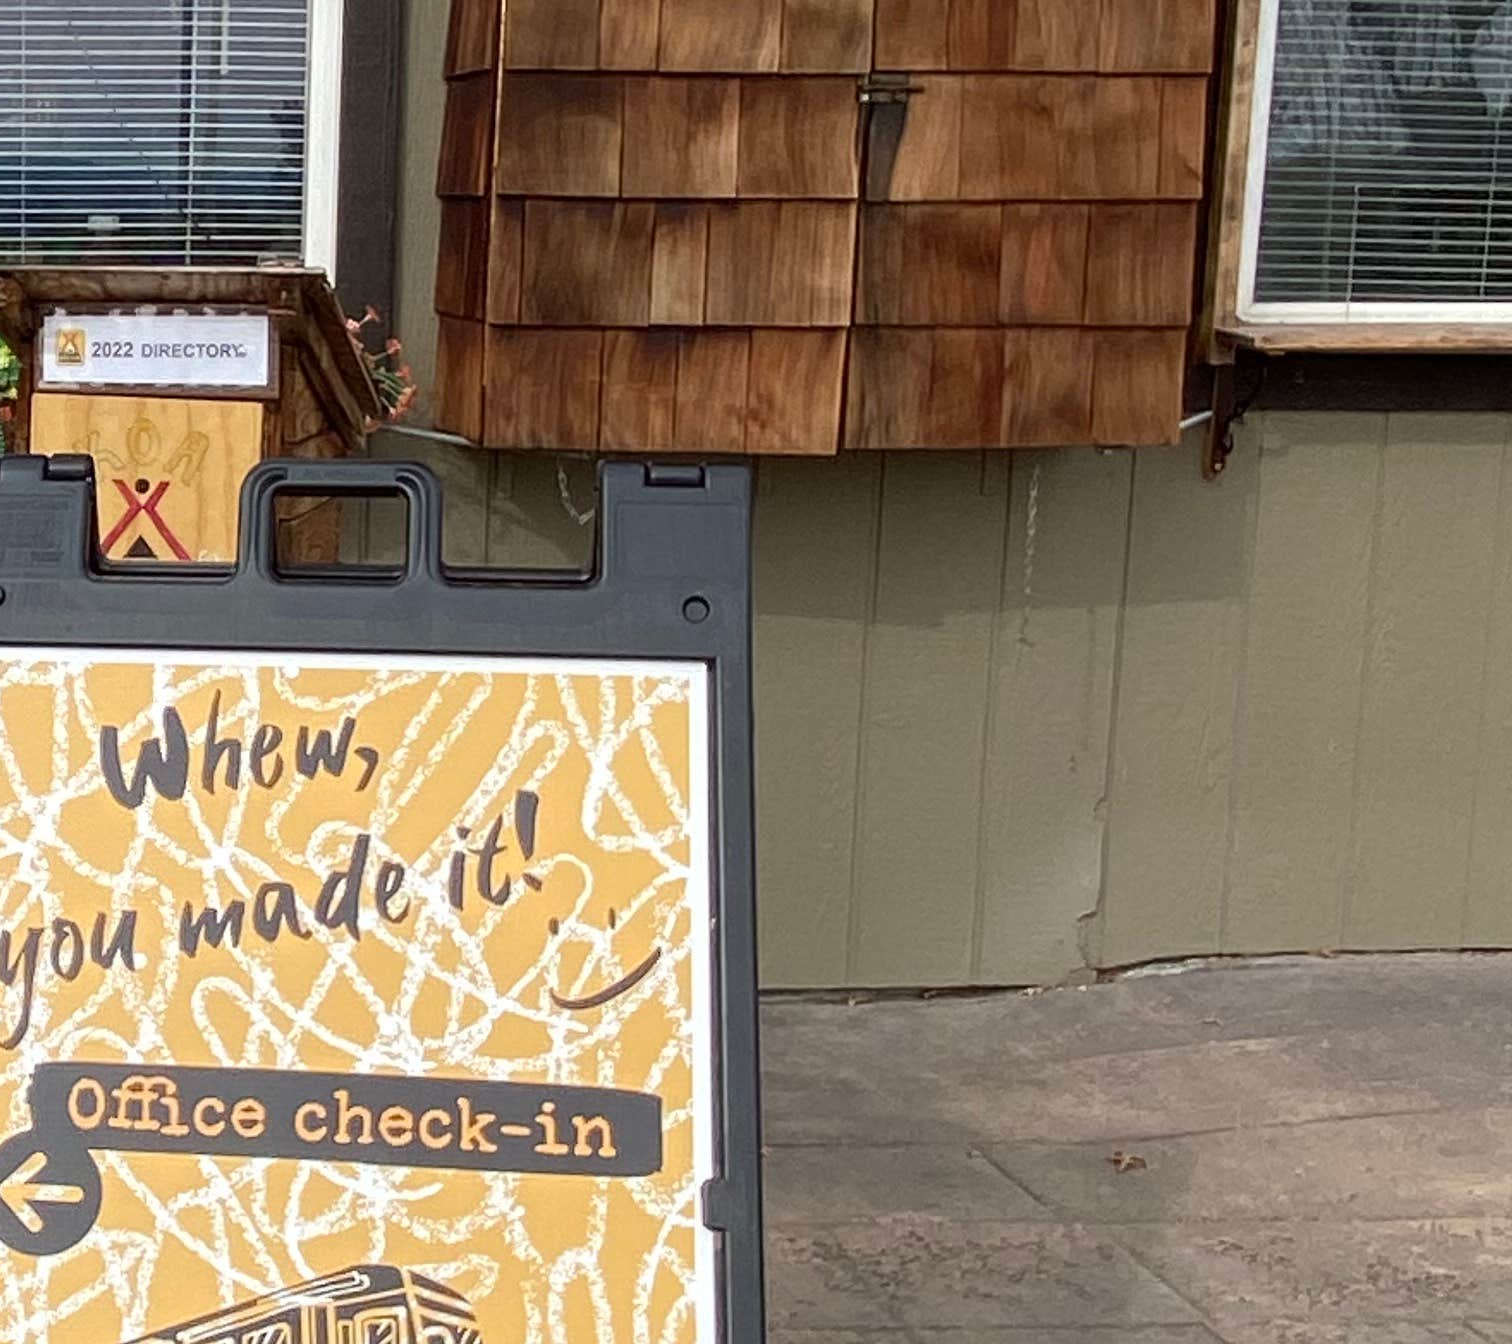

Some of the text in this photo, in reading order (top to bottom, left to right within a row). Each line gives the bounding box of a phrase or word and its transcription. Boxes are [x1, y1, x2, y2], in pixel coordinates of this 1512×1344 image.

[91, 341, 134, 358] 2022
[141, 343, 245, 359] DIRECTORY
[100, 689, 380, 810] Whew,
[178, 833, 411, 959] made
[448, 789, 545, 912] it!
[67, 1075, 619, 1159] Office check-in
